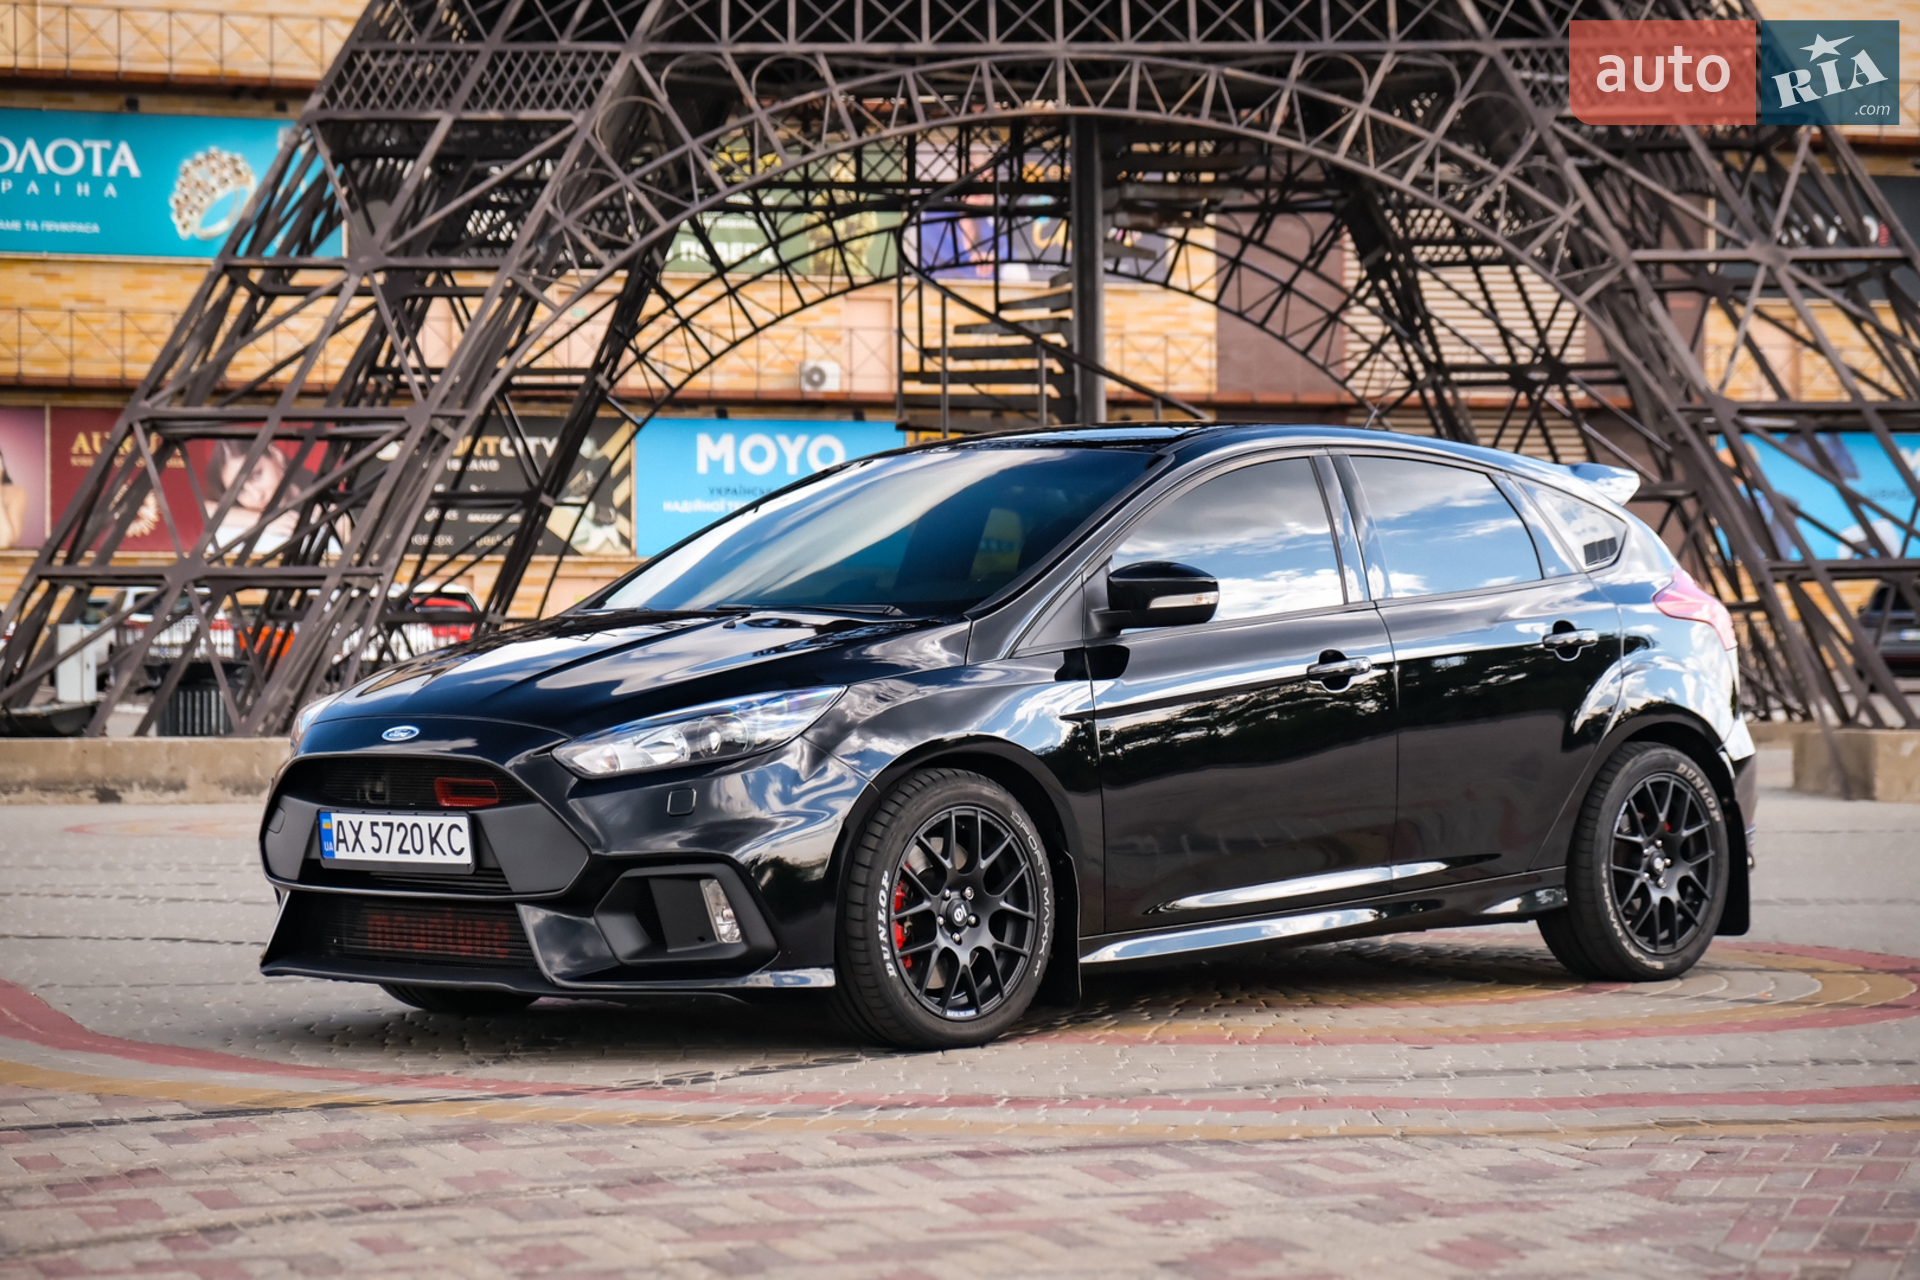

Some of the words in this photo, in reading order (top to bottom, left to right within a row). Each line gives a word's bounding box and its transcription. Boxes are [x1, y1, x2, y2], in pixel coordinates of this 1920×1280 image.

[24, 219, 40, 232] ТА
[697, 433, 846, 476] MOYO
[1676, 763, 1721, 822] DUNLOP
[324, 841, 333, 851] UA
[336, 820, 366, 854] AX
[370, 821, 424, 856] 5720
[428, 822, 465, 857] KC
[1010, 811, 1048, 881] SPORT
[1038, 886, 1051, 956] MAXX
[877, 870, 898, 979] DUNLOP
